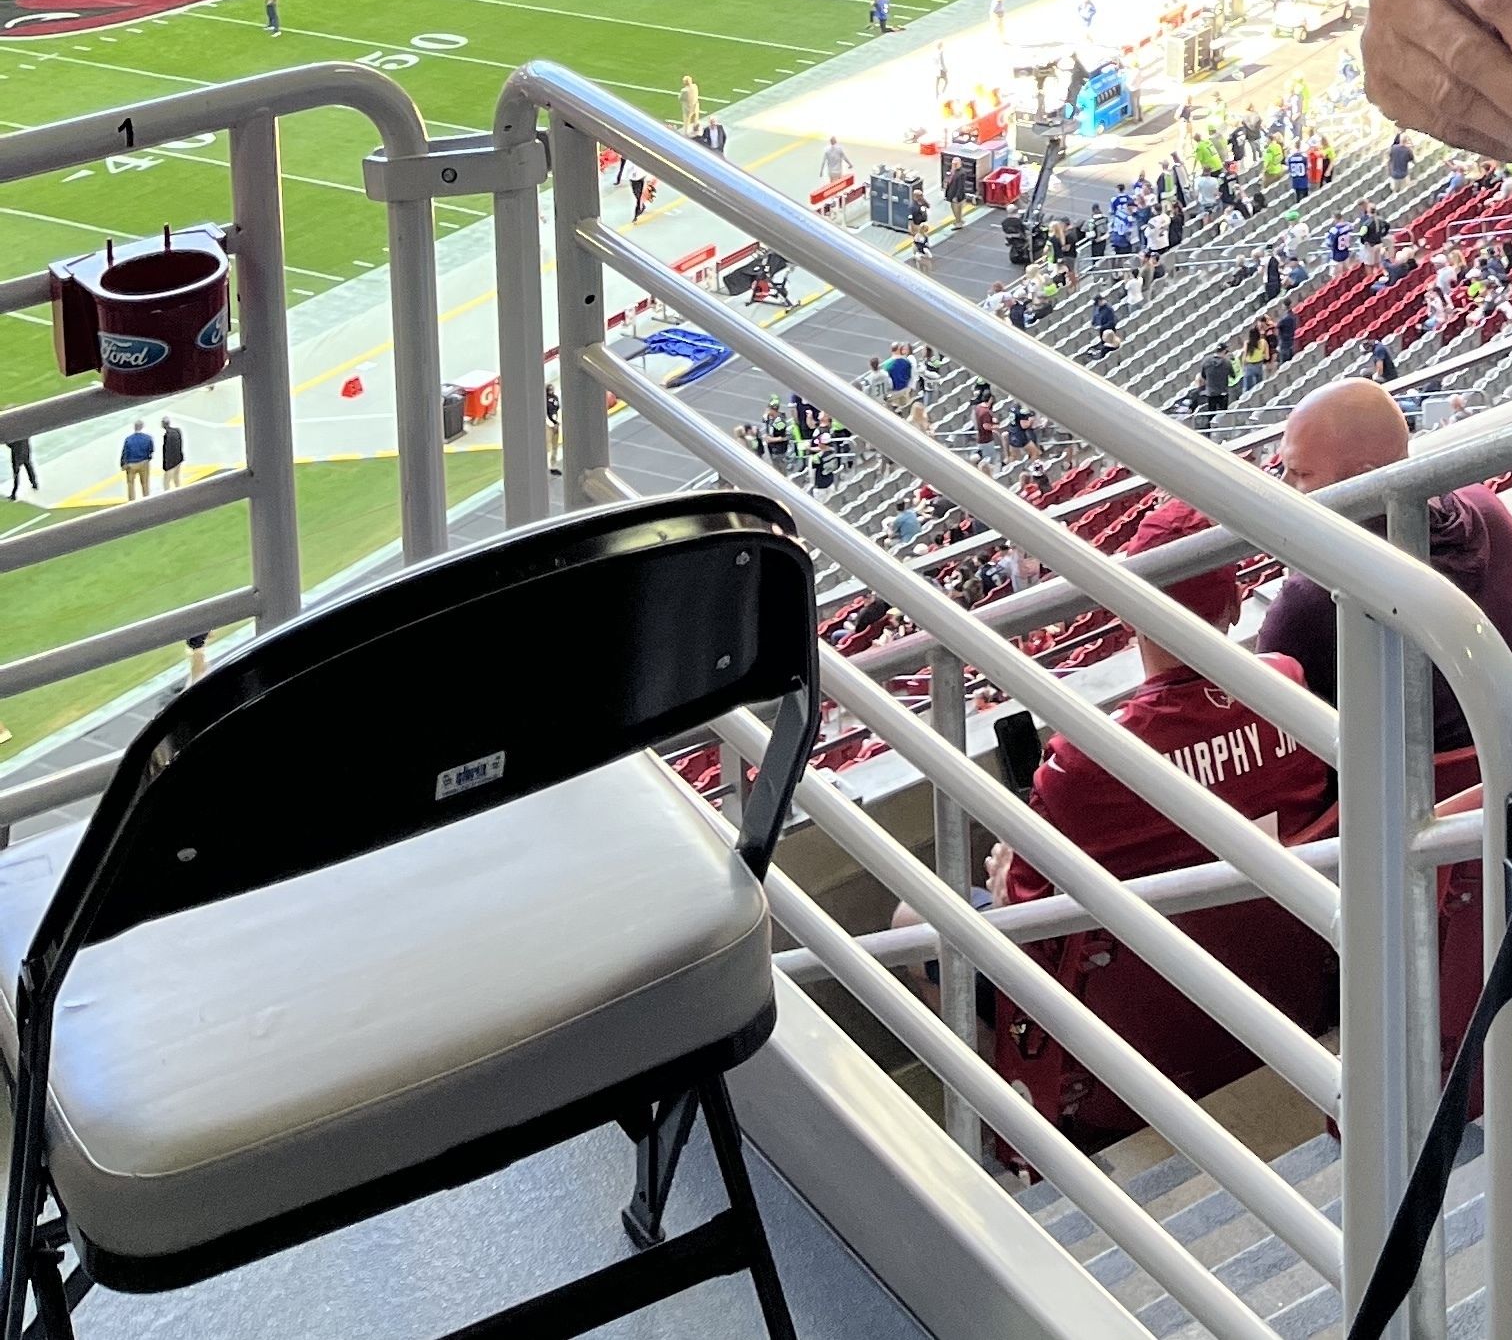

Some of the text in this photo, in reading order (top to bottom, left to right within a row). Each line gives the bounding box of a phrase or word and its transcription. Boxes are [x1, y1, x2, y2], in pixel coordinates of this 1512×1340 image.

[355, 32, 469, 71] 50
[101, 341, 148, 367] Ford
[1163, 722, 1263, 787] URPHY
